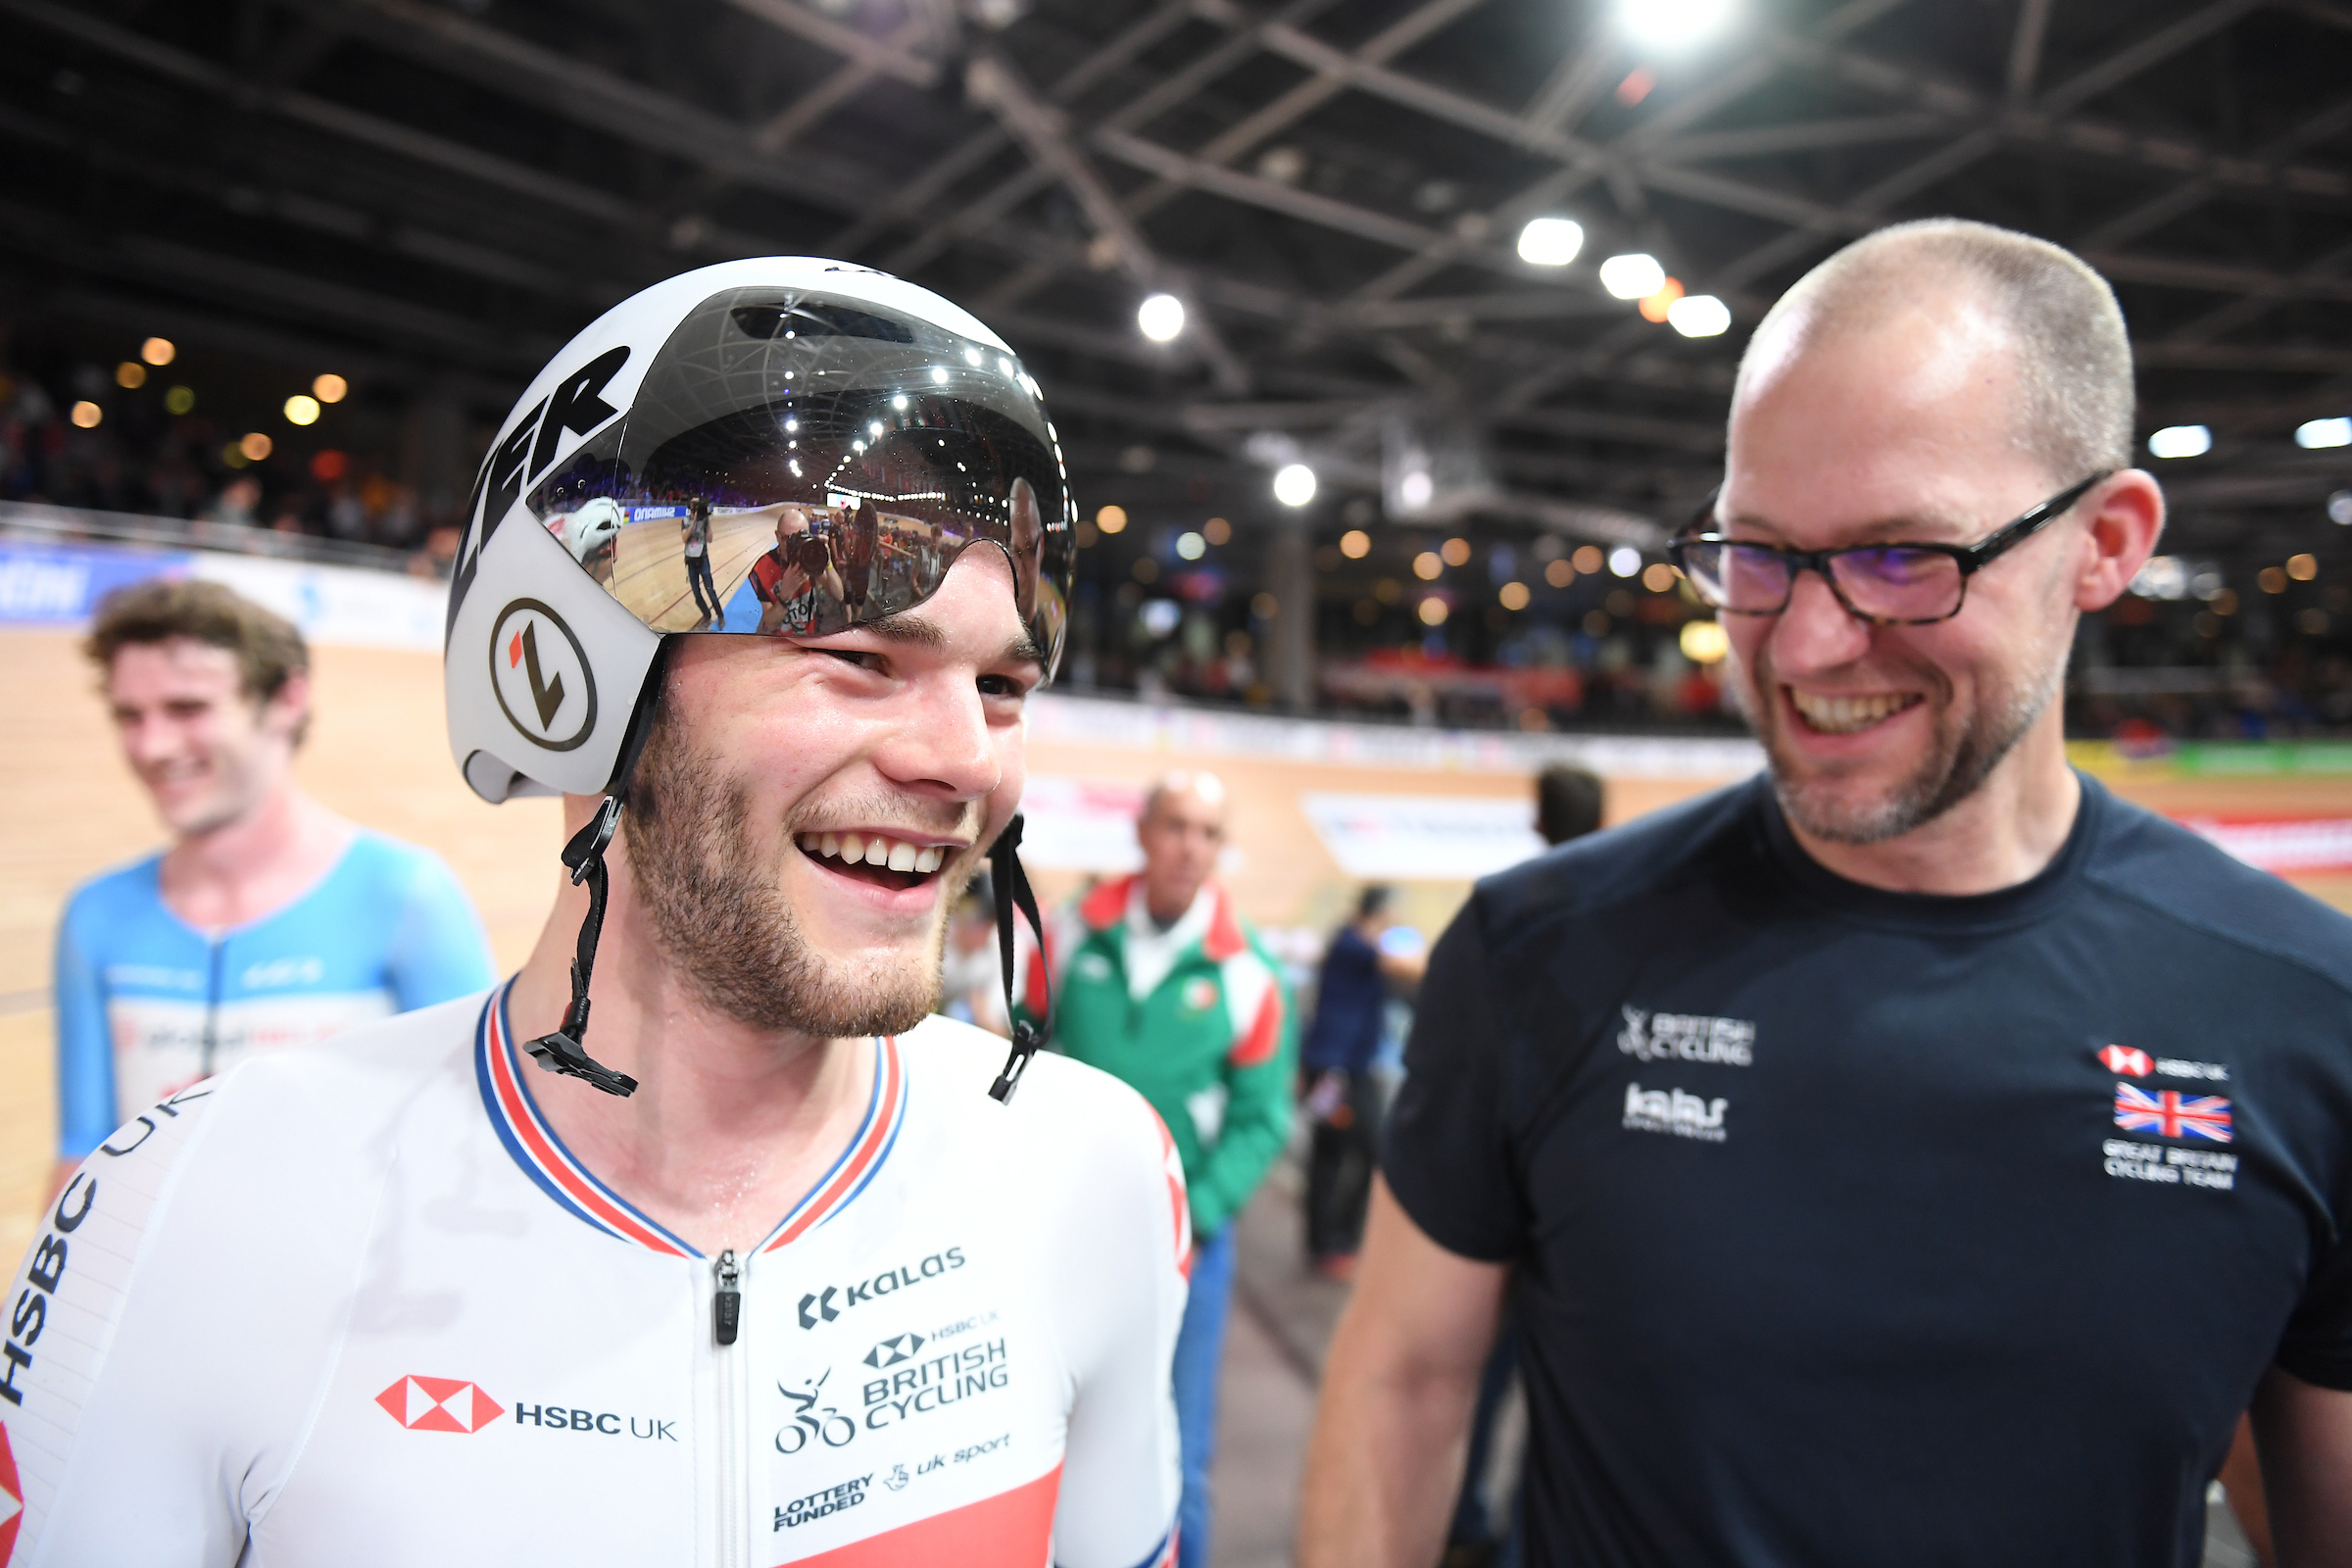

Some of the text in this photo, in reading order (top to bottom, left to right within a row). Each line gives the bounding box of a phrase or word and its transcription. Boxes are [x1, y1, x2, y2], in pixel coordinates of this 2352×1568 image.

[1650, 1034, 1753, 1066] CYCLING
[0, 1172, 97, 1406] HSBC
[100, 1087, 214, 1157] UK
[932, 1315, 978, 1342] HSBC
[862, 1338, 1006, 1406] BRITISH
[865, 1363, 1008, 1430] CYCLING
[515, 1401, 678, 1443] HSBC UK
[954, 1433, 1010, 1464] sport
[773, 1492, 865, 1533] FUNDED
[774, 1473, 873, 1519] LOTTERY
